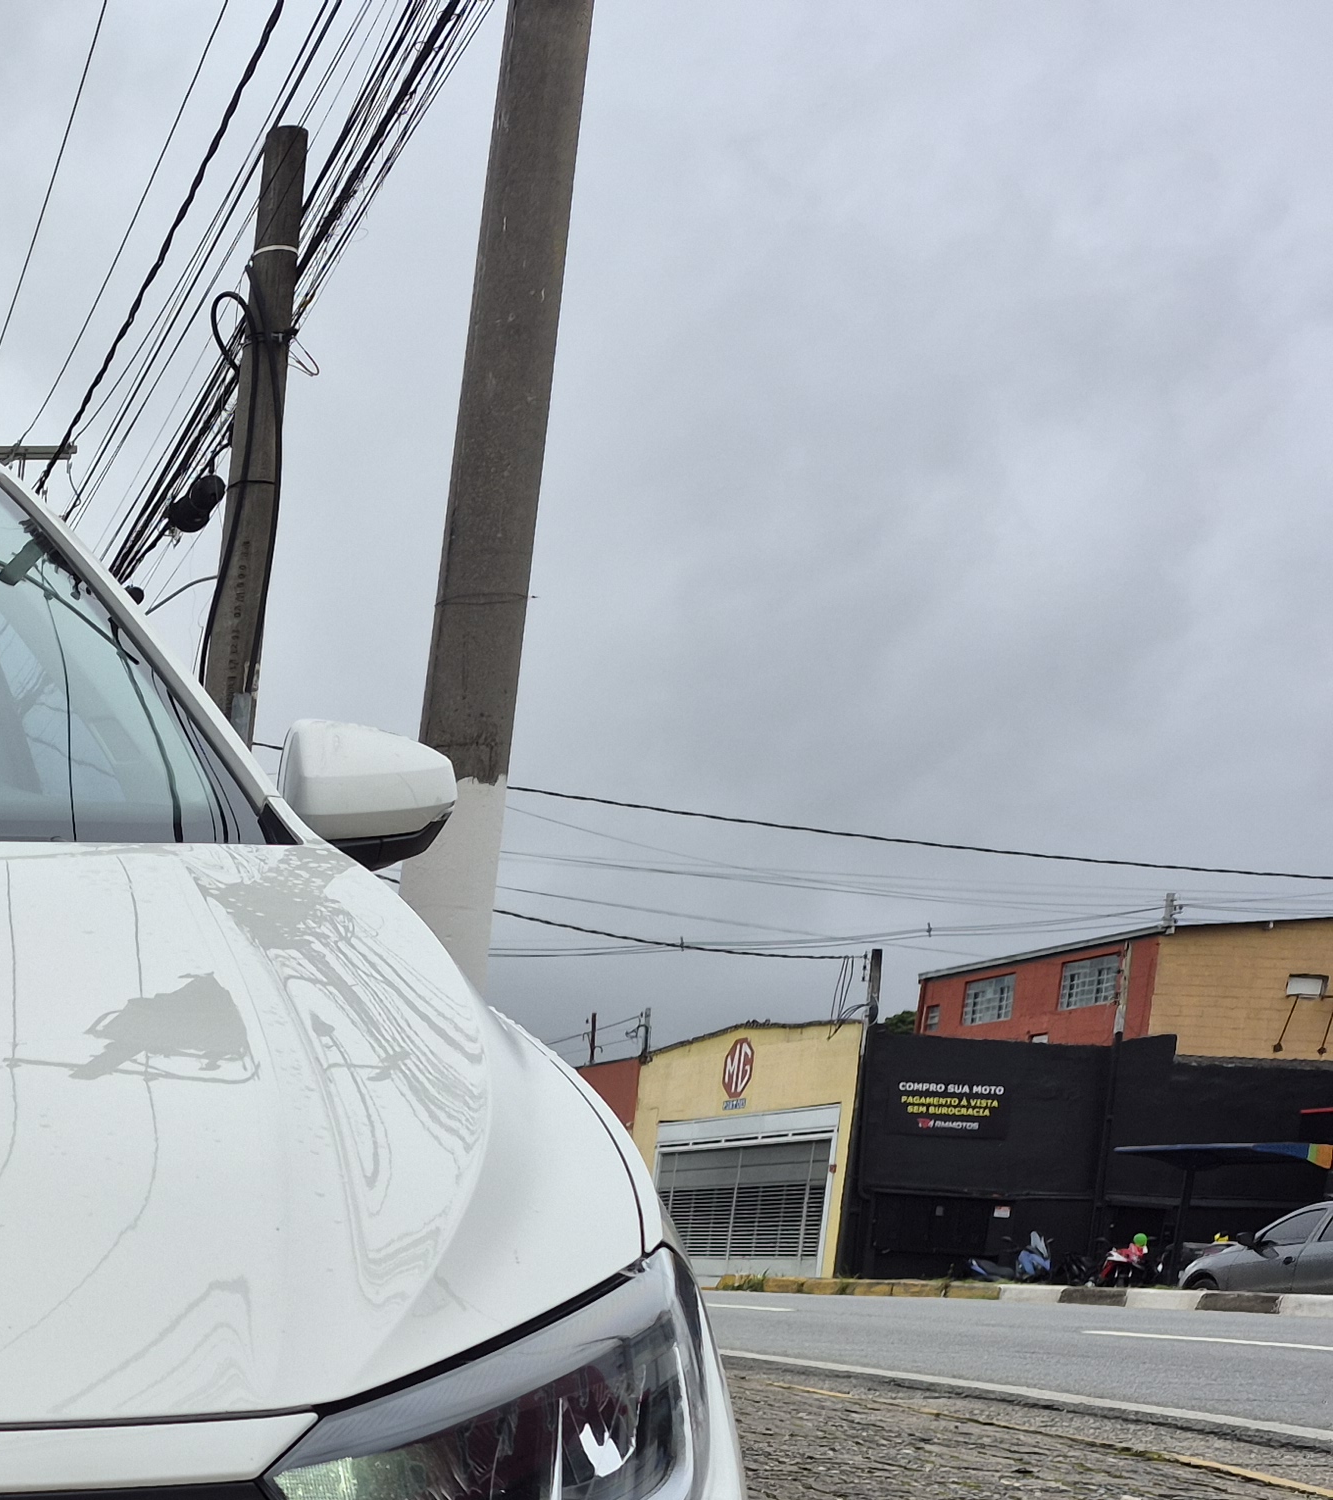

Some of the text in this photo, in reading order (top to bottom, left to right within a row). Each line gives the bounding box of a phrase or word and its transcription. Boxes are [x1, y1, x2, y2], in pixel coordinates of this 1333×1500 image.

[724, 1042, 752, 1093] MG
[899, 1081, 1004, 1095] COMPRO SUA MOTO
[901, 1095, 959, 1106] PAGAMENTO
[969, 1098, 999, 1108] VISTA
[907, 1105, 990, 1117] SEM BUROCRACIA
